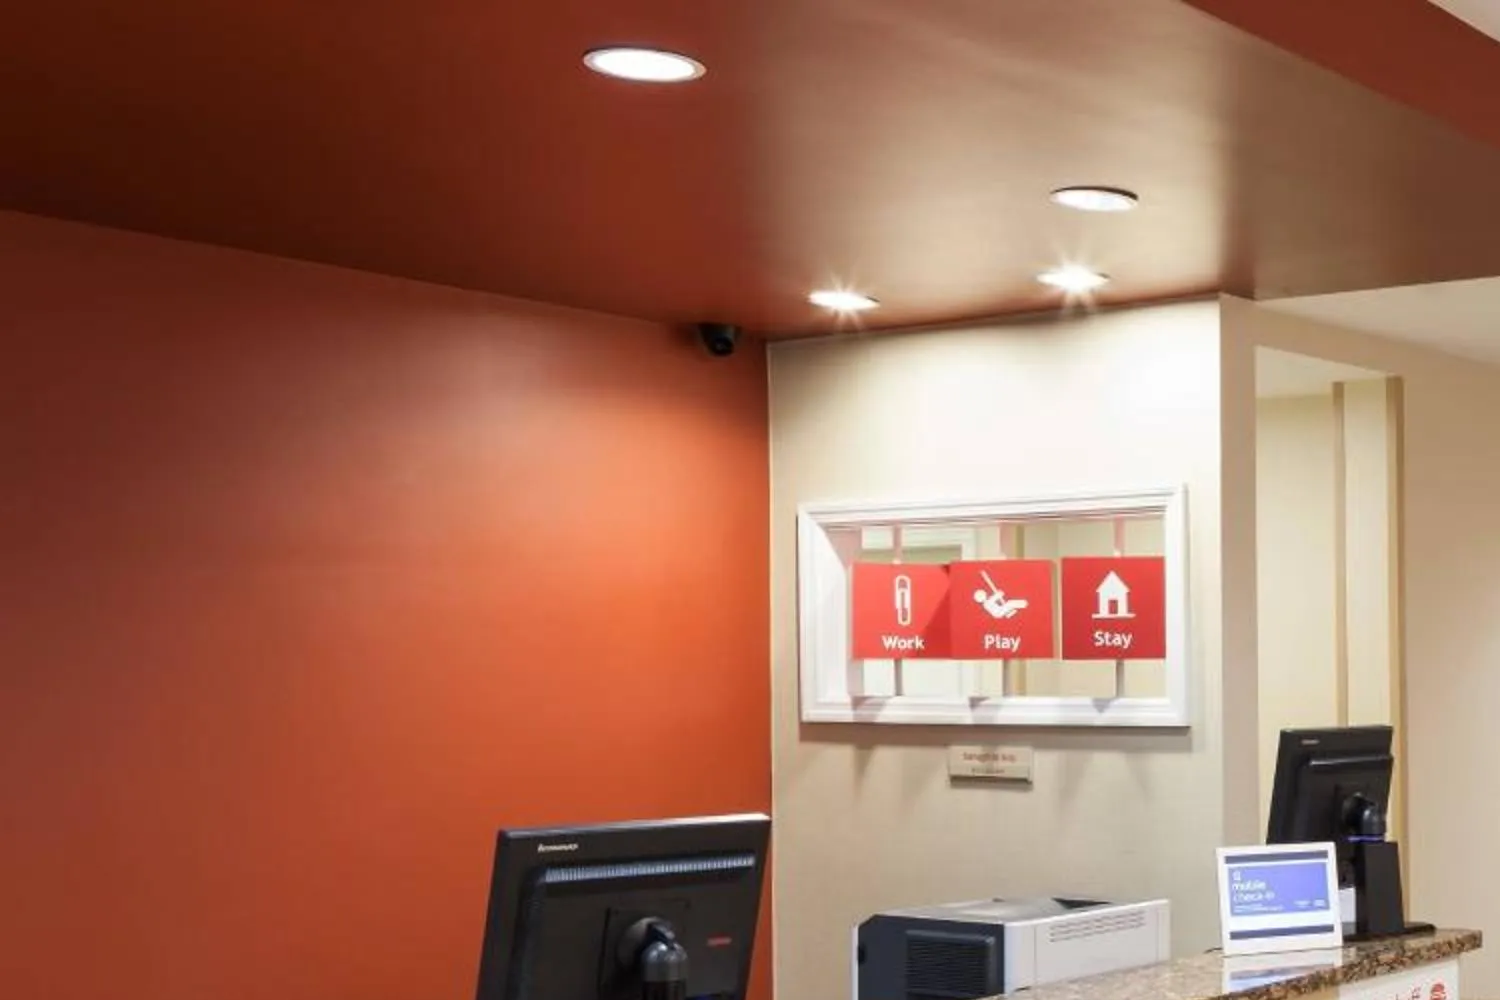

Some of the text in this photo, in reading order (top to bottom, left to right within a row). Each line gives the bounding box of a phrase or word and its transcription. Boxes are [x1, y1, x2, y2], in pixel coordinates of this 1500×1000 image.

[882, 634, 925, 650] Work
[984, 634, 1021, 653] Play
[1094, 630, 1133, 650] Stay
